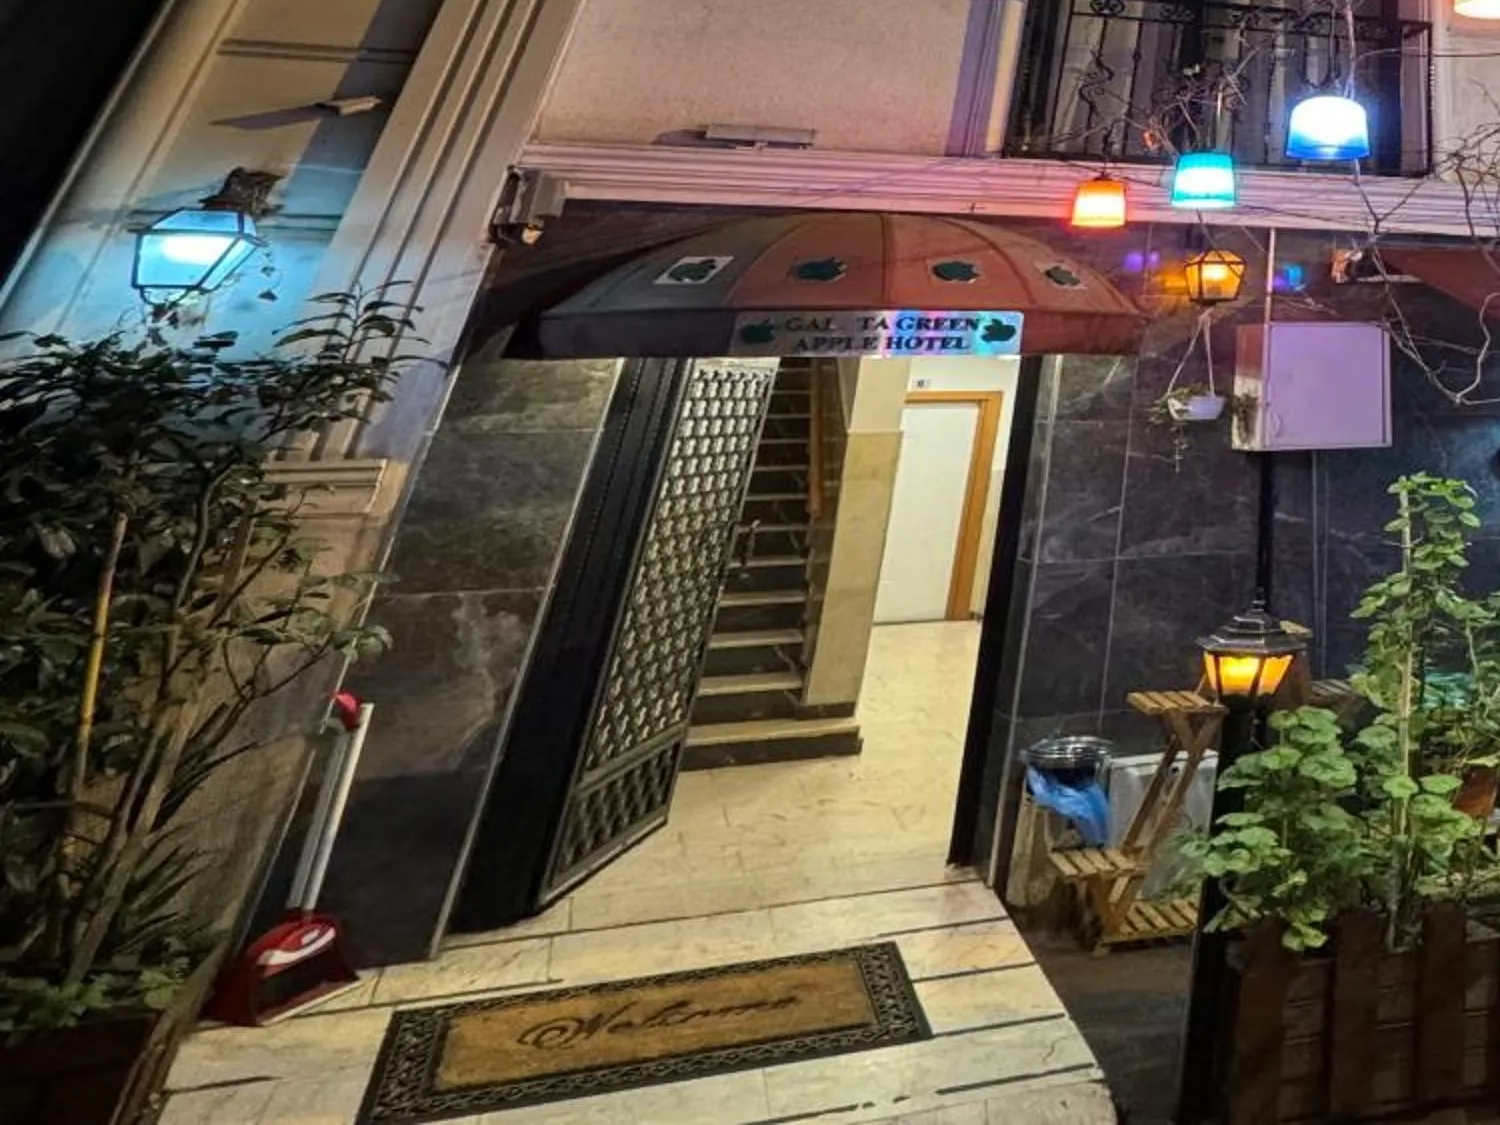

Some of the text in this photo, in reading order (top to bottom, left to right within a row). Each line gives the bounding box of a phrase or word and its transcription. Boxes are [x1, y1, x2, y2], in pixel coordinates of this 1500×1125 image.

[895, 315, 980, 332] GREEN
[794, 336, 971, 352] APPLE HOTEL
